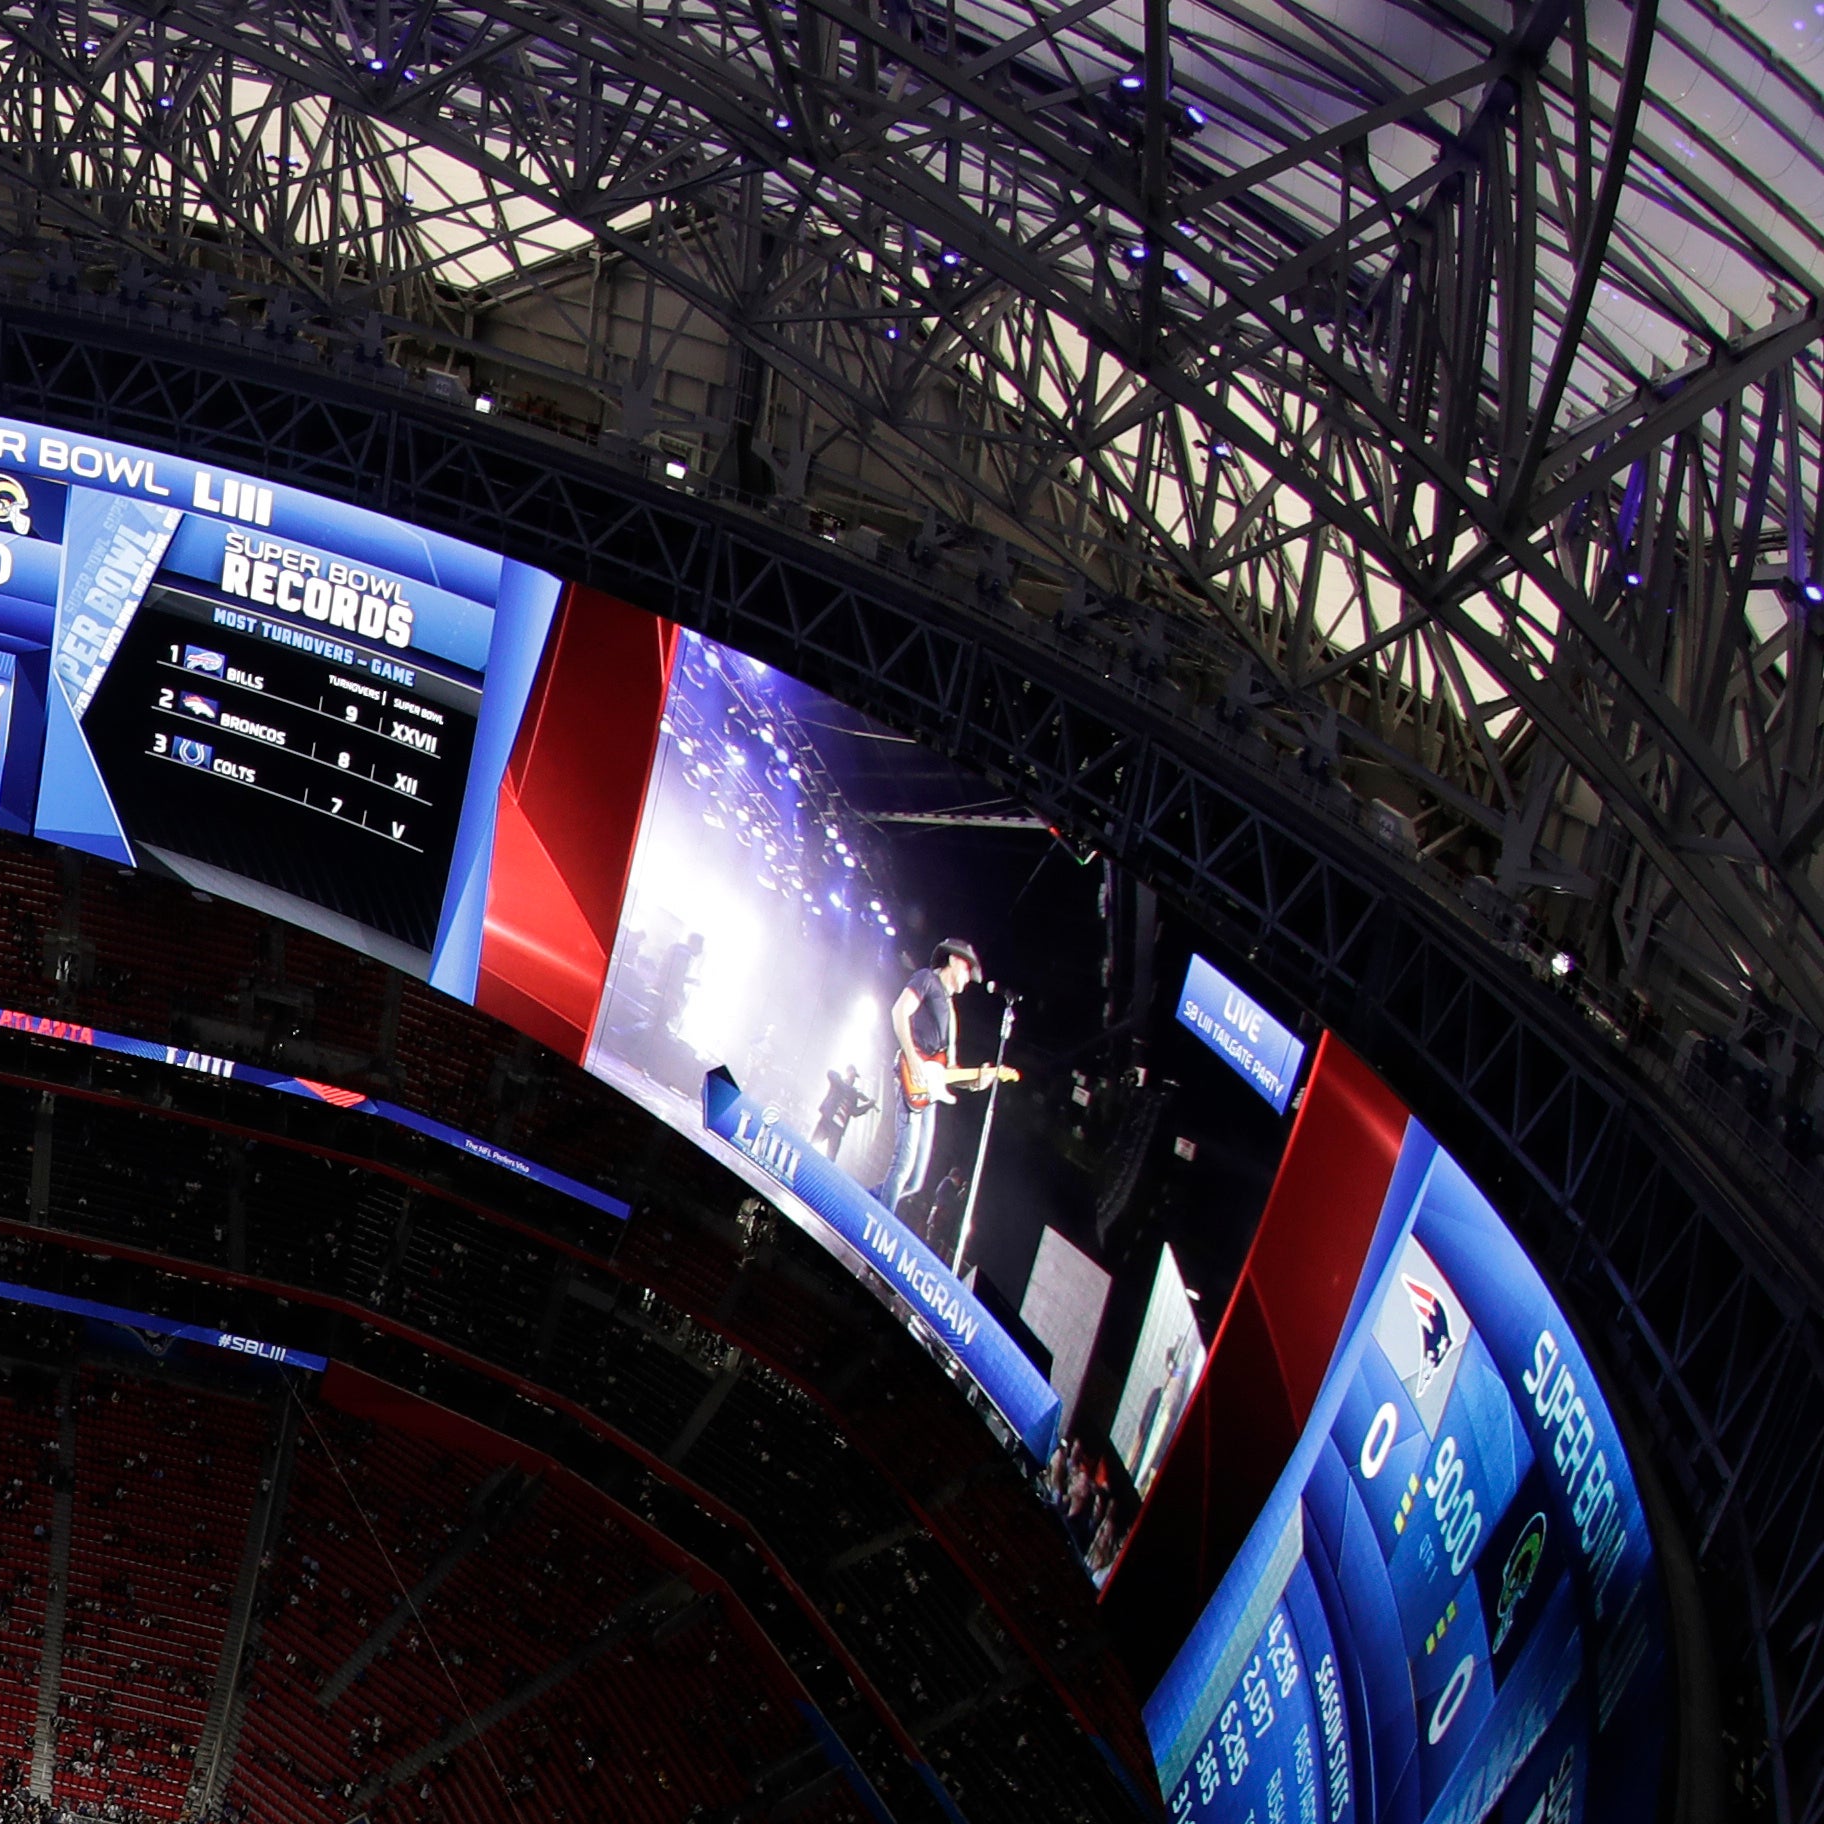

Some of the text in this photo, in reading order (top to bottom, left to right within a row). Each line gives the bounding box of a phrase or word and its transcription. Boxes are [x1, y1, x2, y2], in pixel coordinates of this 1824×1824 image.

[39, 439, 171, 497] BOWL
[193, 471, 273, 526] LIII
[221, 551, 414, 649] RECORDS
[224, 531, 410, 607] SUPER BOWL
[214, 608, 415, 687] MOST TURNOVERS GAME
[226, 668, 437, 753] BILLS XXVII
[220, 712, 417, 795] BRONCOS XII
[213, 758, 405, 838] COLTS V
[1223, 991, 1262, 1043] LIVE
[863, 1212, 980, 1345] TIM McGRAW
[218, 1333, 286, 1361] #SBLIII
[1520, 1330, 1598, 1500] SUPER
[1423, 1436, 1482, 1576] 90:00
